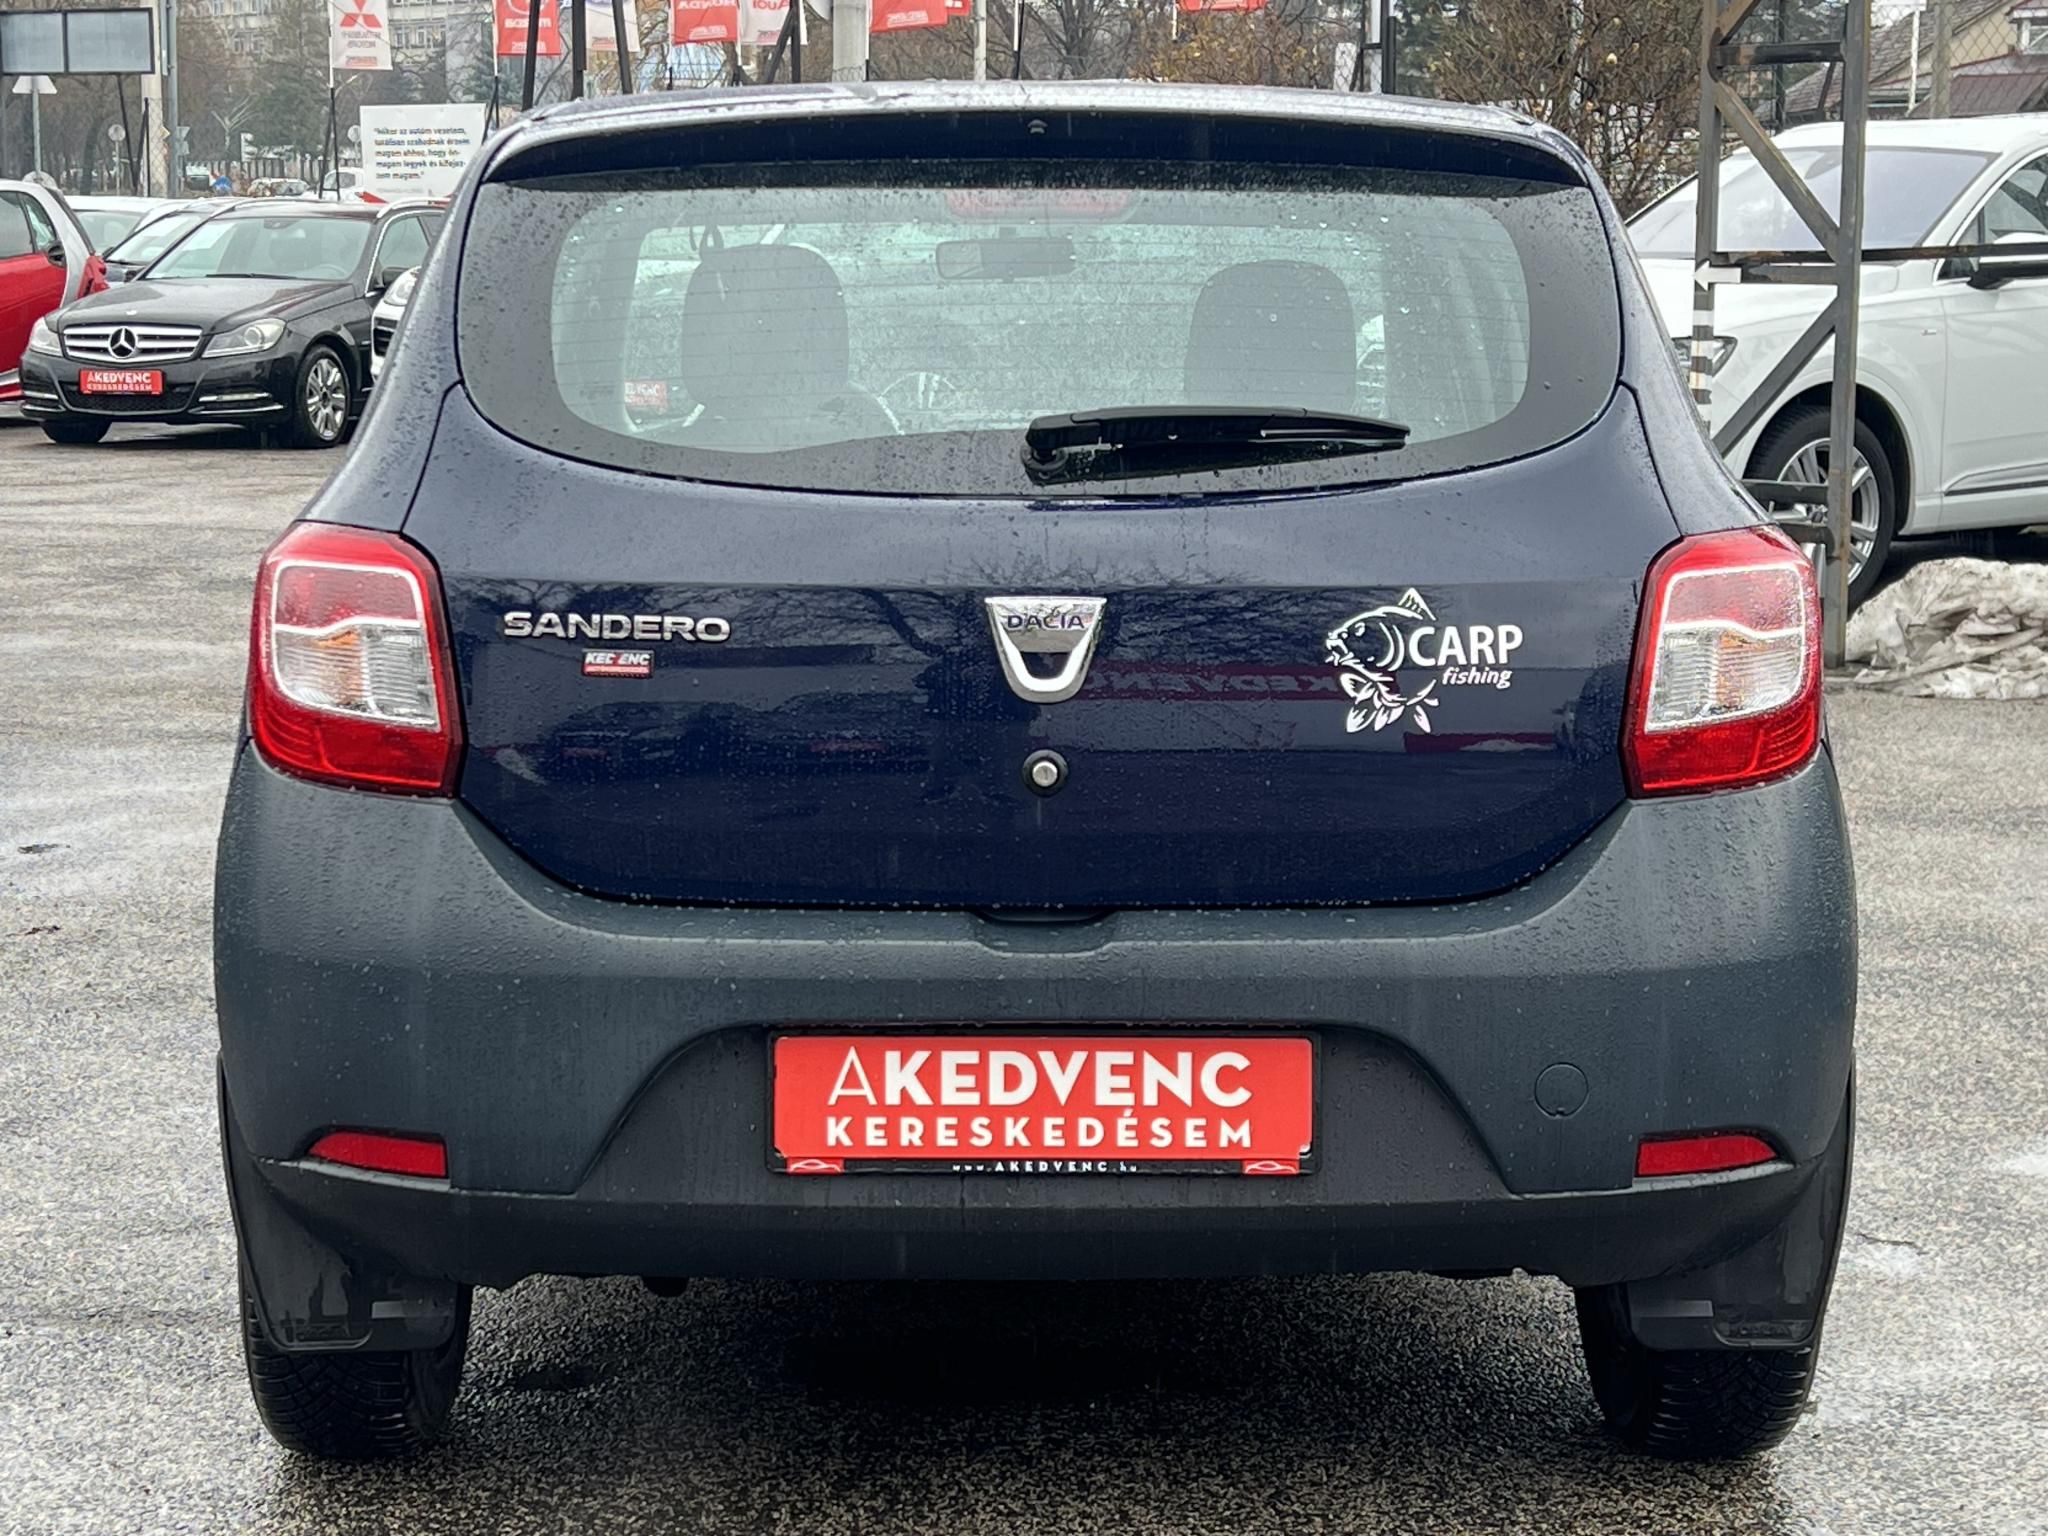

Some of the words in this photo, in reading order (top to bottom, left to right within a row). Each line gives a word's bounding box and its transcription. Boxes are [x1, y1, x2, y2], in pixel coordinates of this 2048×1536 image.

[87, 371, 151, 383] AKEDVENC
[503, 611, 732, 642] SANDERO
[1007, 615, 1085, 629] DACIA
[1408, 624, 1524, 667] CARP
[1441, 667, 1513, 689] fishing
[827, 1046, 1254, 1107] AKEDVENC
[827, 1109, 1252, 1149] KERESKEDÉSEM
